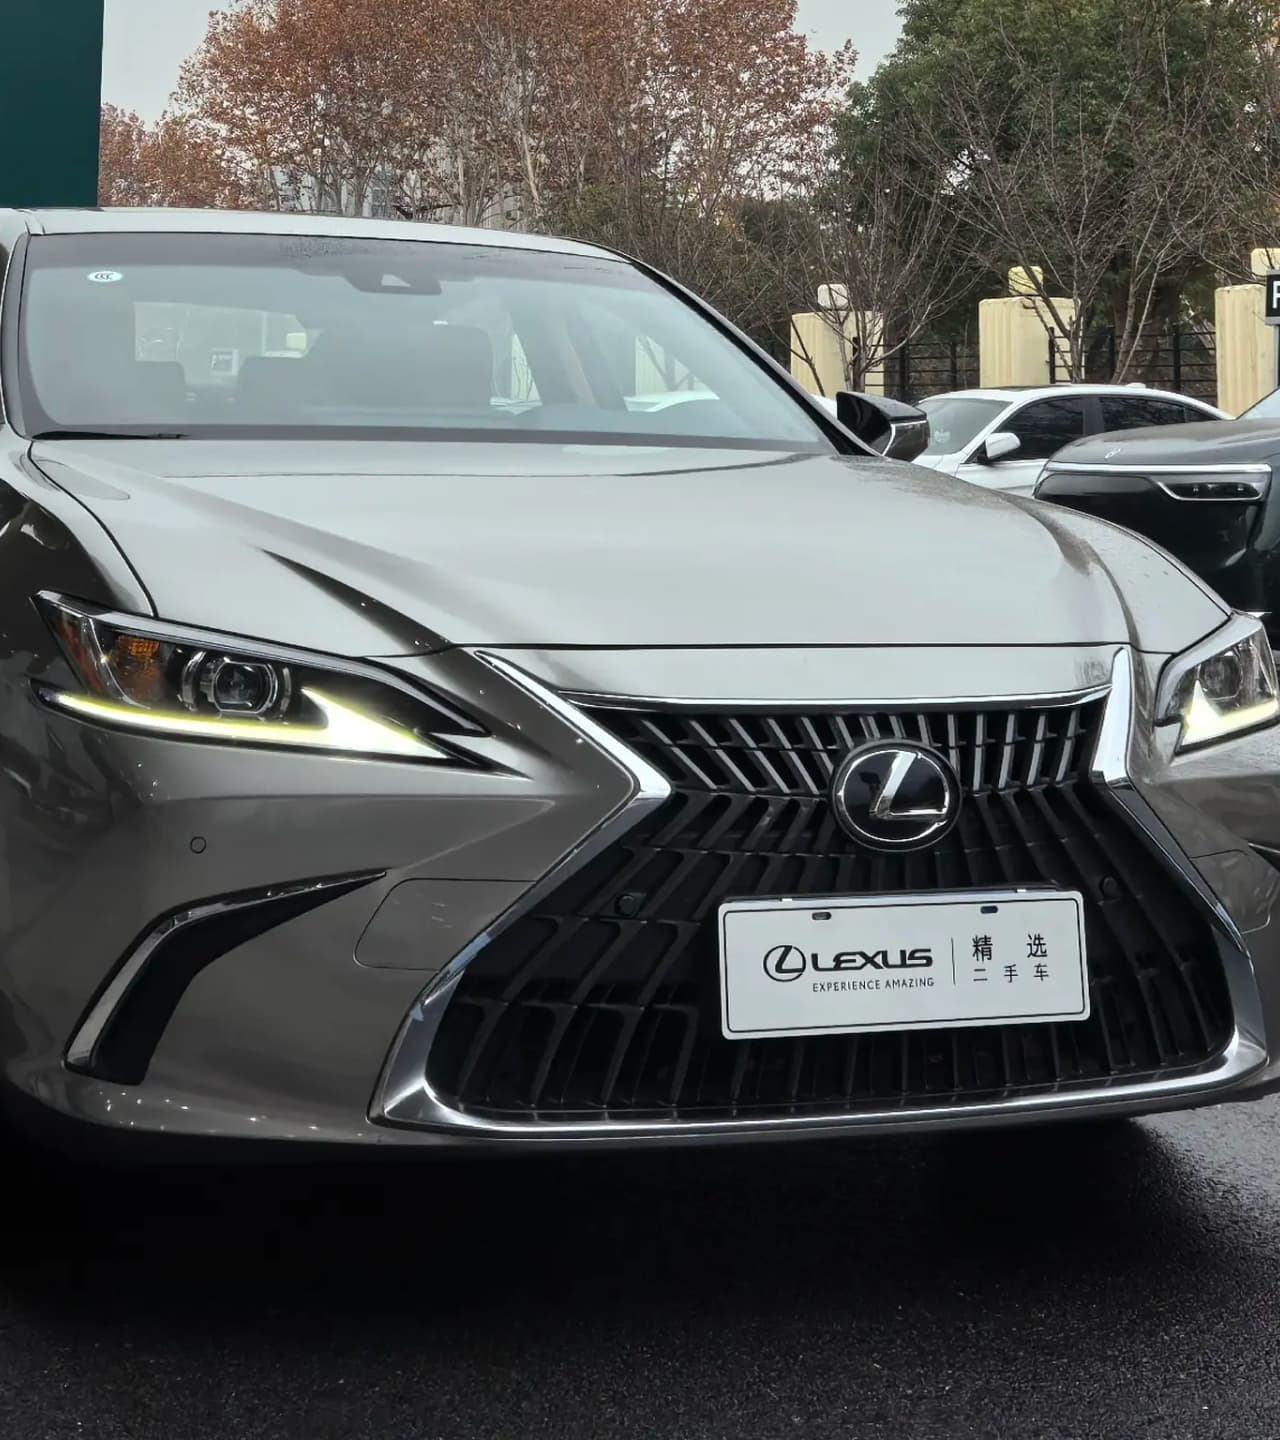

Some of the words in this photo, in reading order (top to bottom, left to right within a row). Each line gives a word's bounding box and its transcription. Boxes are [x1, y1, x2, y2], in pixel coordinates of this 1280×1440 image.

[972, 933, 1049, 962] 精选
[810, 948, 933, 972] LEXUS
[811, 979, 882, 993] EXPERIENCE
[884, 976, 935, 990] AMAZING
[972, 962, 1050, 984] 二手车
